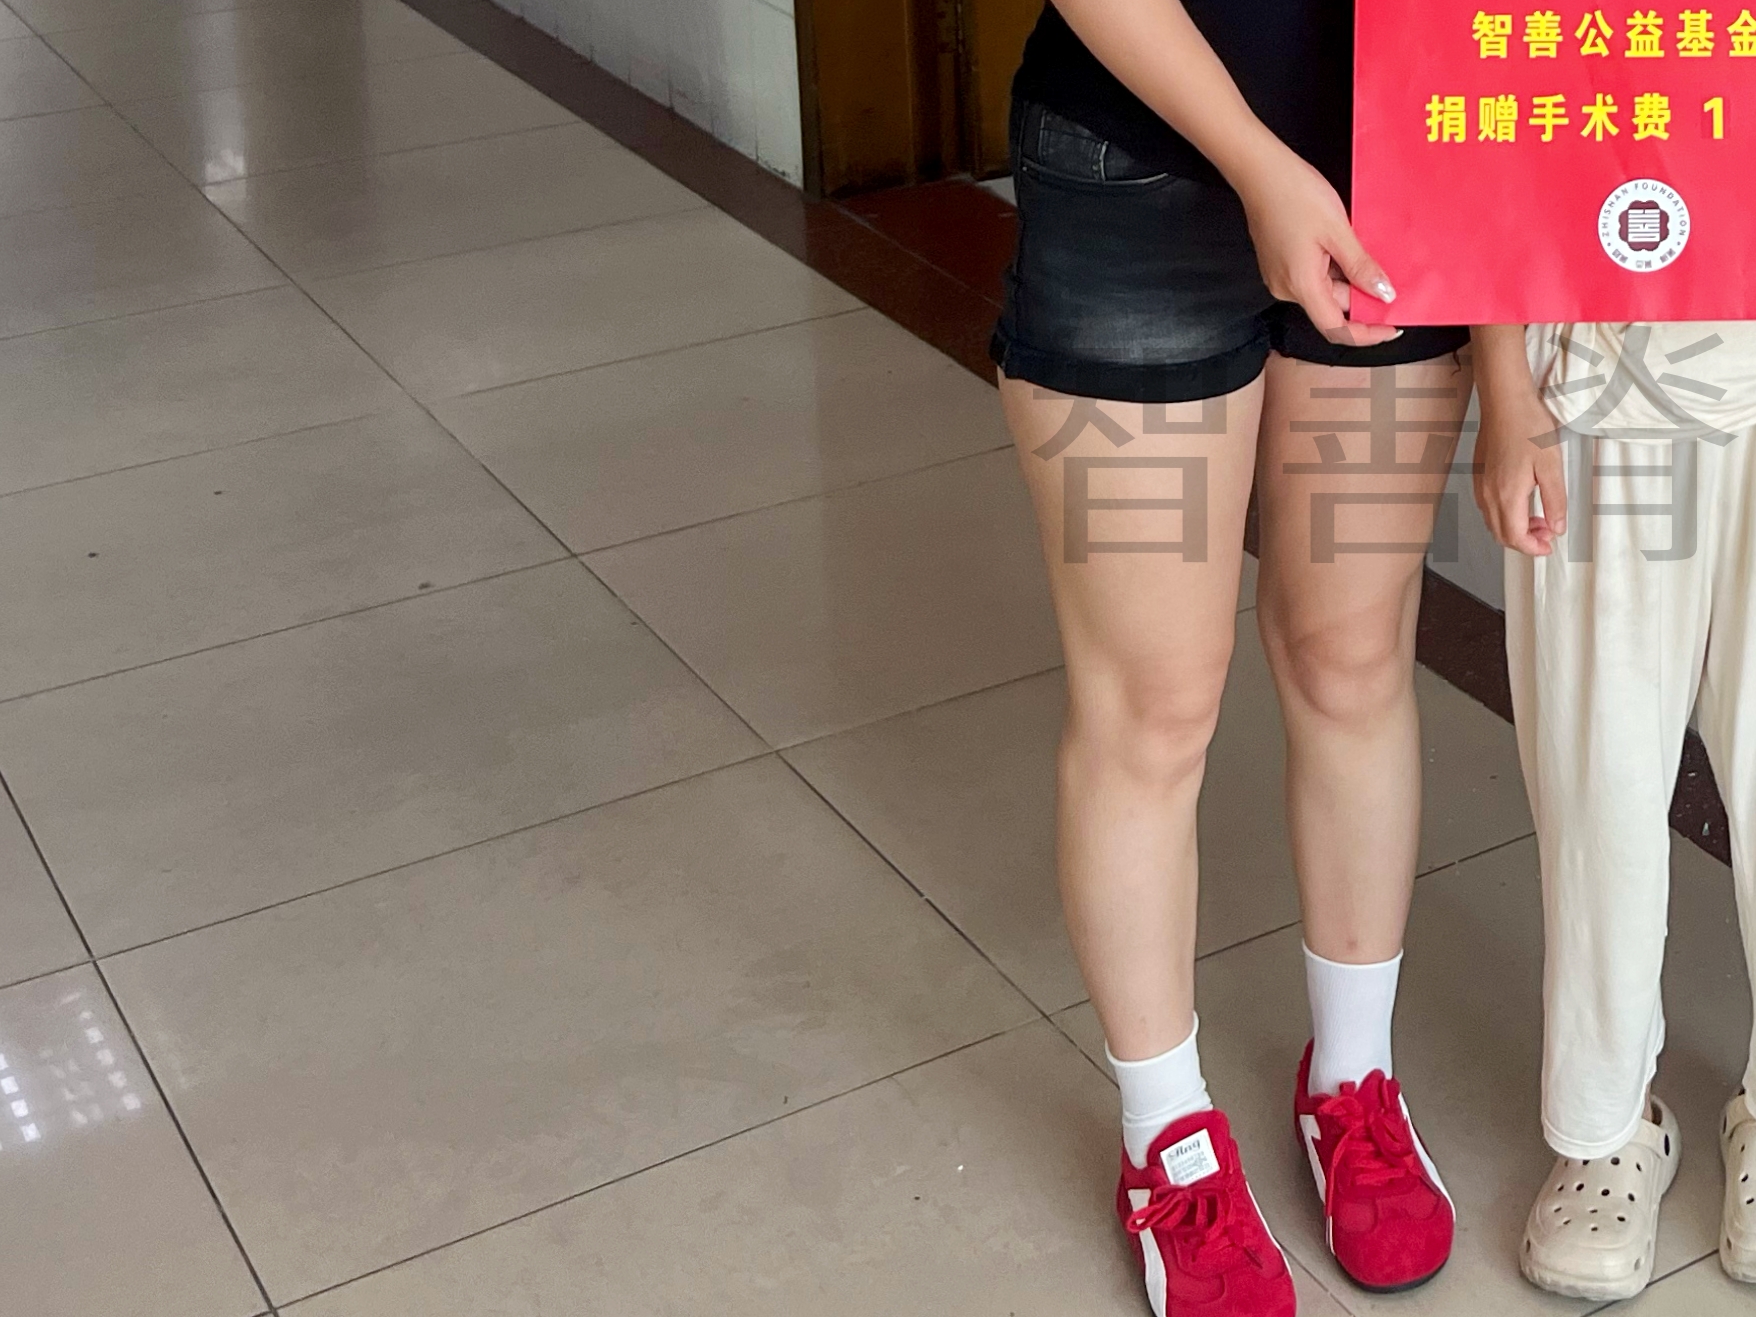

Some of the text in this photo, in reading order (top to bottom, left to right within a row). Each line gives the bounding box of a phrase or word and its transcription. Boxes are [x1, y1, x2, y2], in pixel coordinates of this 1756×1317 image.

[1424, 92, 1673, 144] 捐赠手术费
[1703, 96, 1726, 140] 1
[1601, 181, 1688, 238] ZHISHAN FOUNDATION
